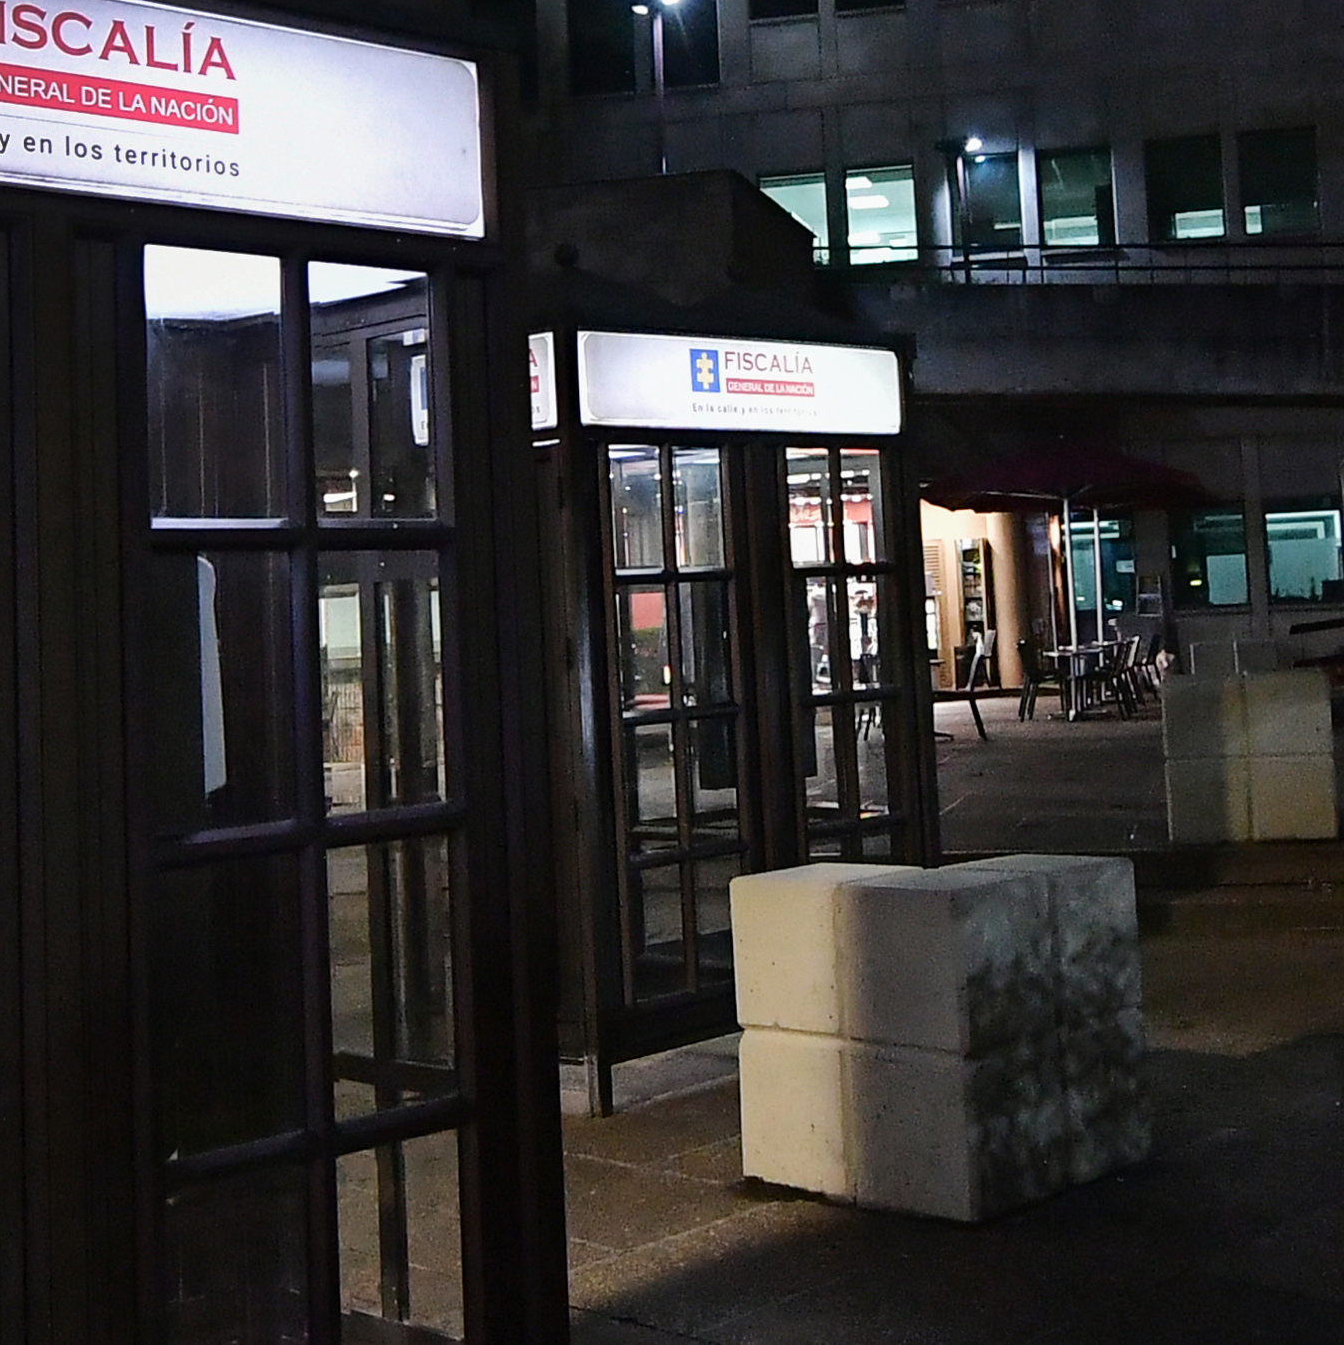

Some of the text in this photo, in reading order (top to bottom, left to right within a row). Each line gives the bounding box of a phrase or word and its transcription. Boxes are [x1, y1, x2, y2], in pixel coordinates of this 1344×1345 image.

[81, 85, 113, 109] DE
[118, 91, 147, 114] LA
[150, 98, 234, 126] NACIÓN
[23, 135, 53, 154] en
[65, 135, 103, 161] los
[114, 144, 240, 177] territorios
[724, 351, 813, 374] FISCALÍA
[728, 381, 764, 394] GENERAL
[764, 383, 775, 394] DE
